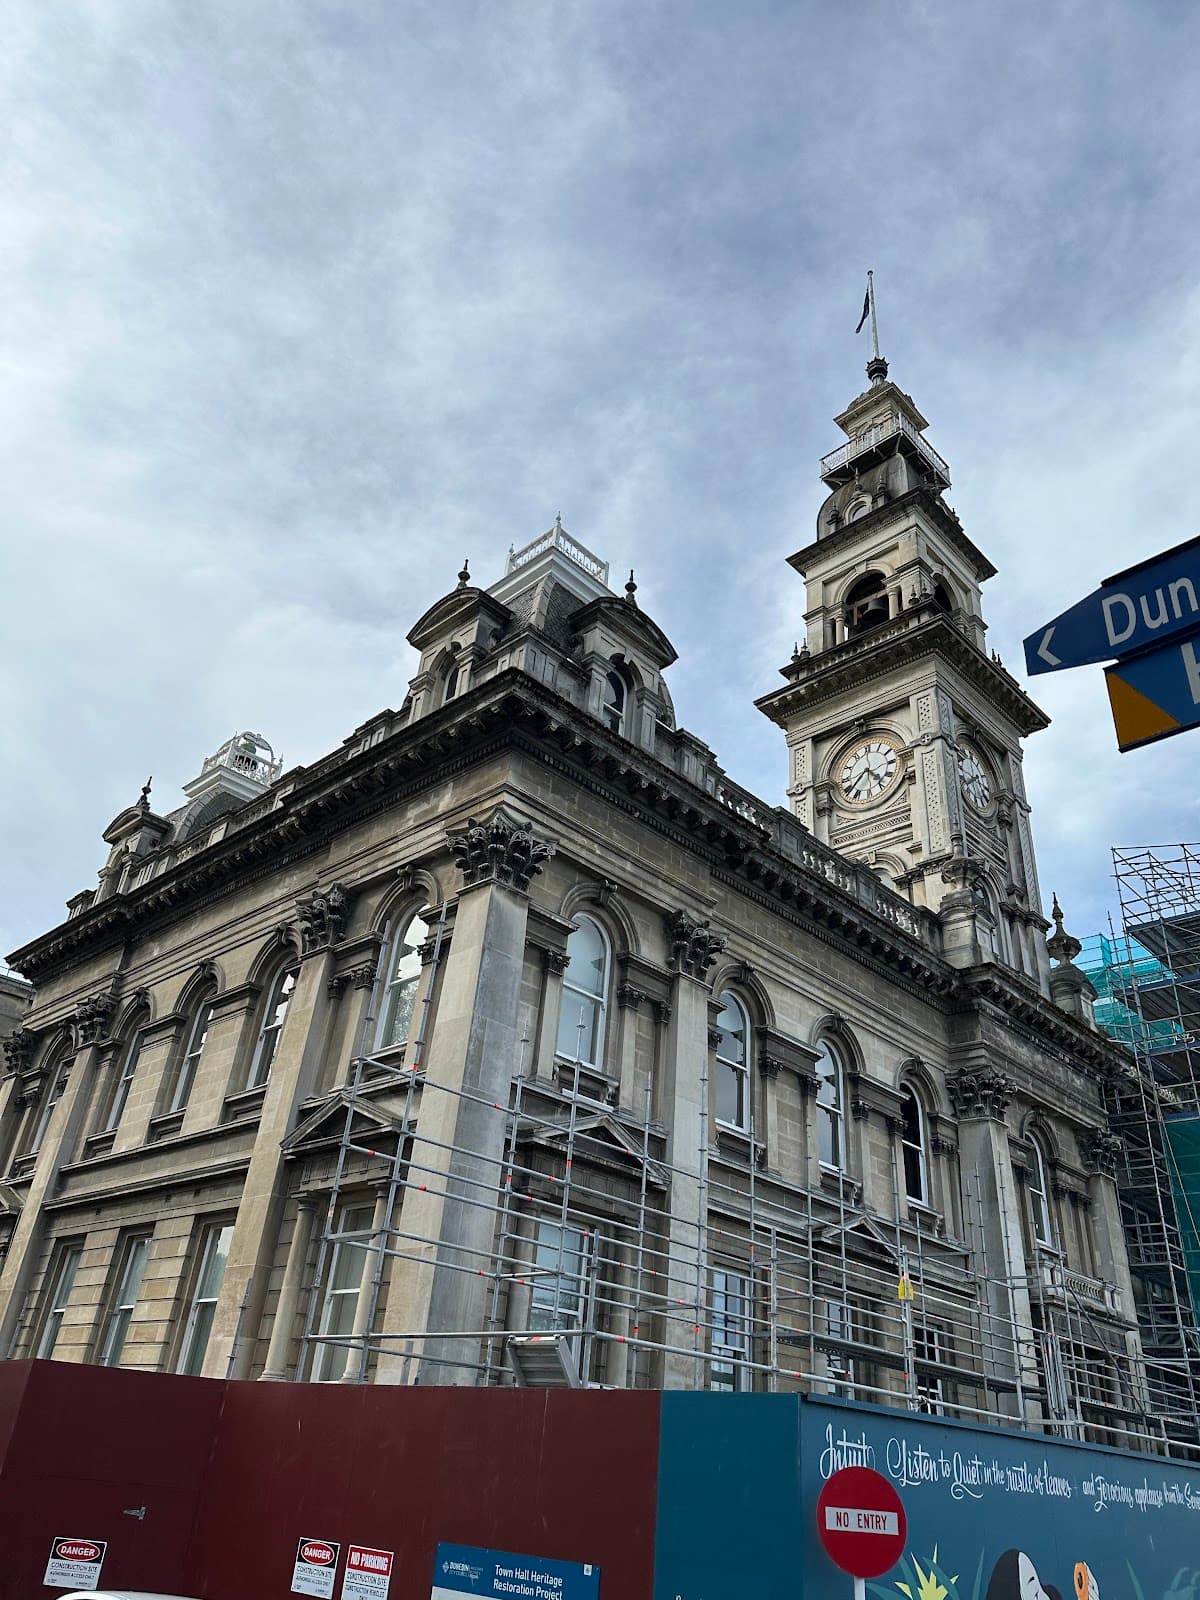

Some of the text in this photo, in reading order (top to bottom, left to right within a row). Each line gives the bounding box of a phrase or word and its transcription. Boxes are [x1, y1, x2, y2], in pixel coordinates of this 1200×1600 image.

[1102, 576, 1199, 648] Dun
[886, 1437, 939, 1487] Listen
[938, 1450, 951, 1478] to
[950, 1452, 984, 1500] Quiet
[983, 1462, 993, 1486] in
[992, 1459, 1005, 1485] the
[1006, 1461, 1034, 1493] rustle
[1034, 1467, 1044, 1496] of
[1043, 1460, 1072, 1498] leaves
[1082, 1472, 1095, 1496] and
[836, 1511, 888, 1530] NO ENTRY
[60, 1546, 95, 1556] DANGER
[304, 1547, 331, 1560] DANGER
[351, 1551, 388, 1571] NO PARKING
[495, 1564, 514, 1578] Town
[514, 1567, 530, 1581] Hall
[530, 1570, 563, 1588] Heritage
[493, 1578, 563, 1600] Restoration Project
